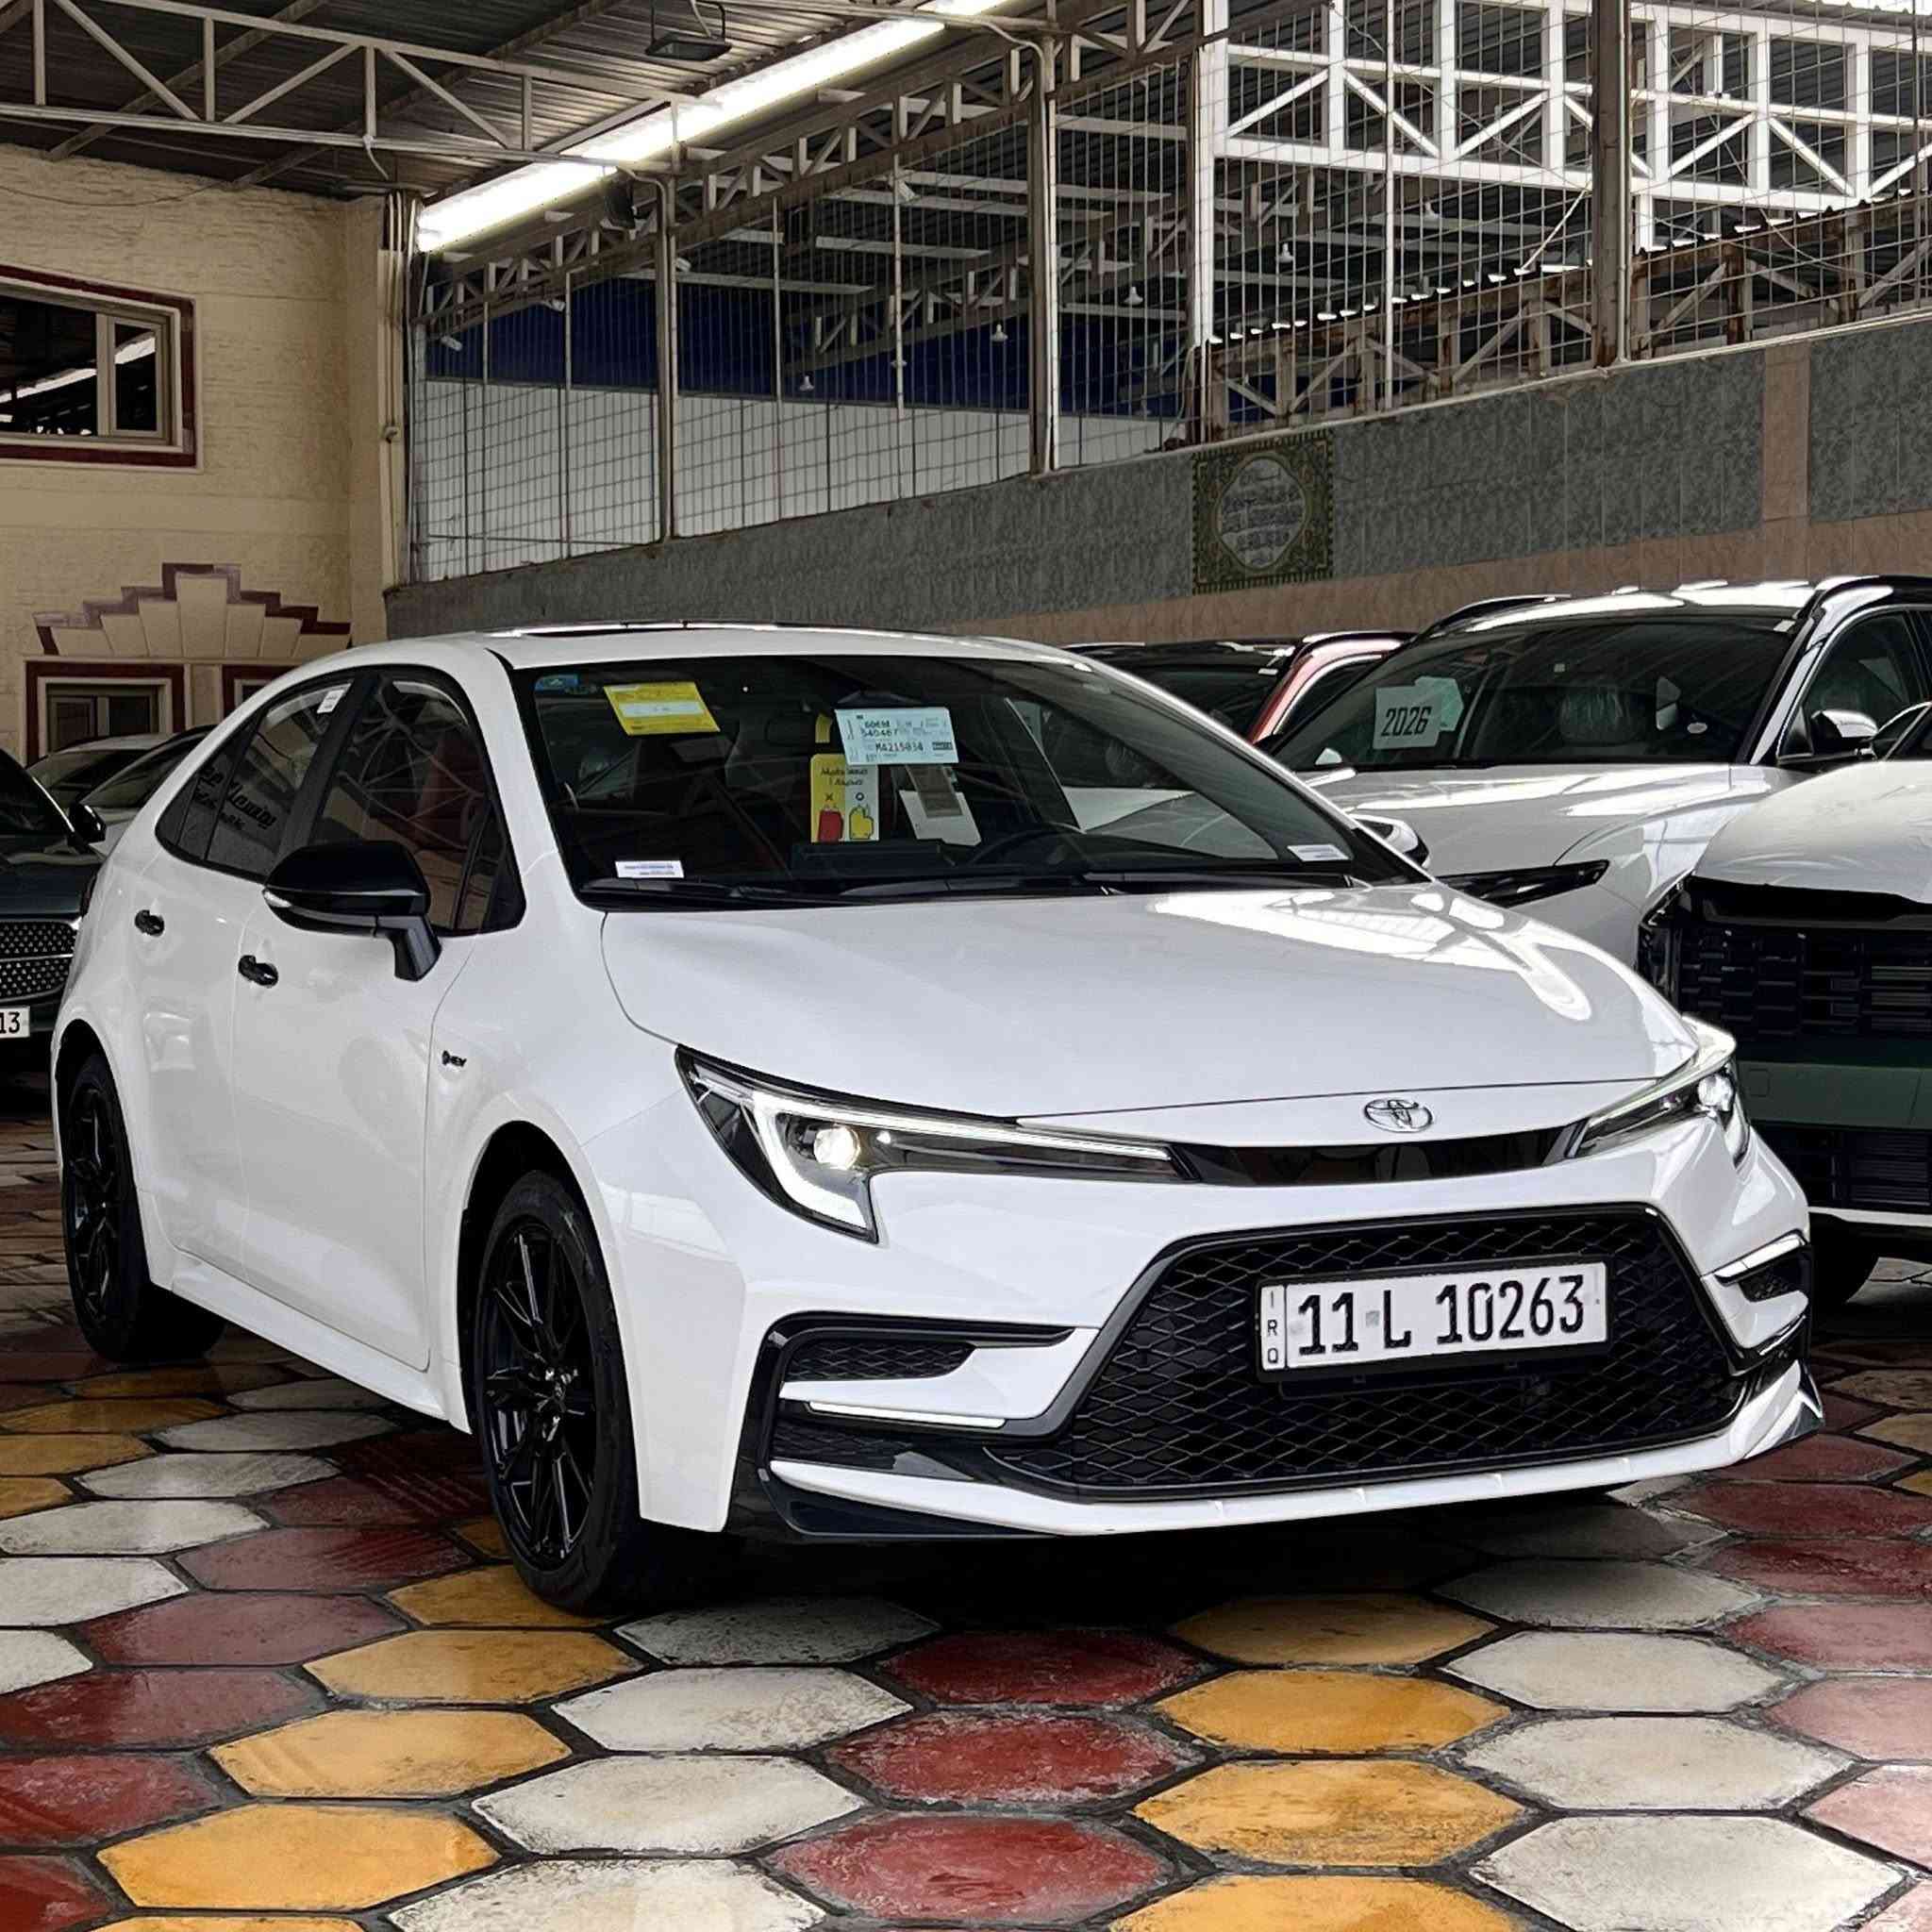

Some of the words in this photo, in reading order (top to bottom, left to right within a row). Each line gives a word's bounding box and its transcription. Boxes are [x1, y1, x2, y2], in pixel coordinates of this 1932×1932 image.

[1381, 707, 1433, 737] 2026
[1298, 1292, 1359, 1356] 11
[1383, 1290, 1412, 1349] L
[1435, 1274, 1584, 1345] 10263
